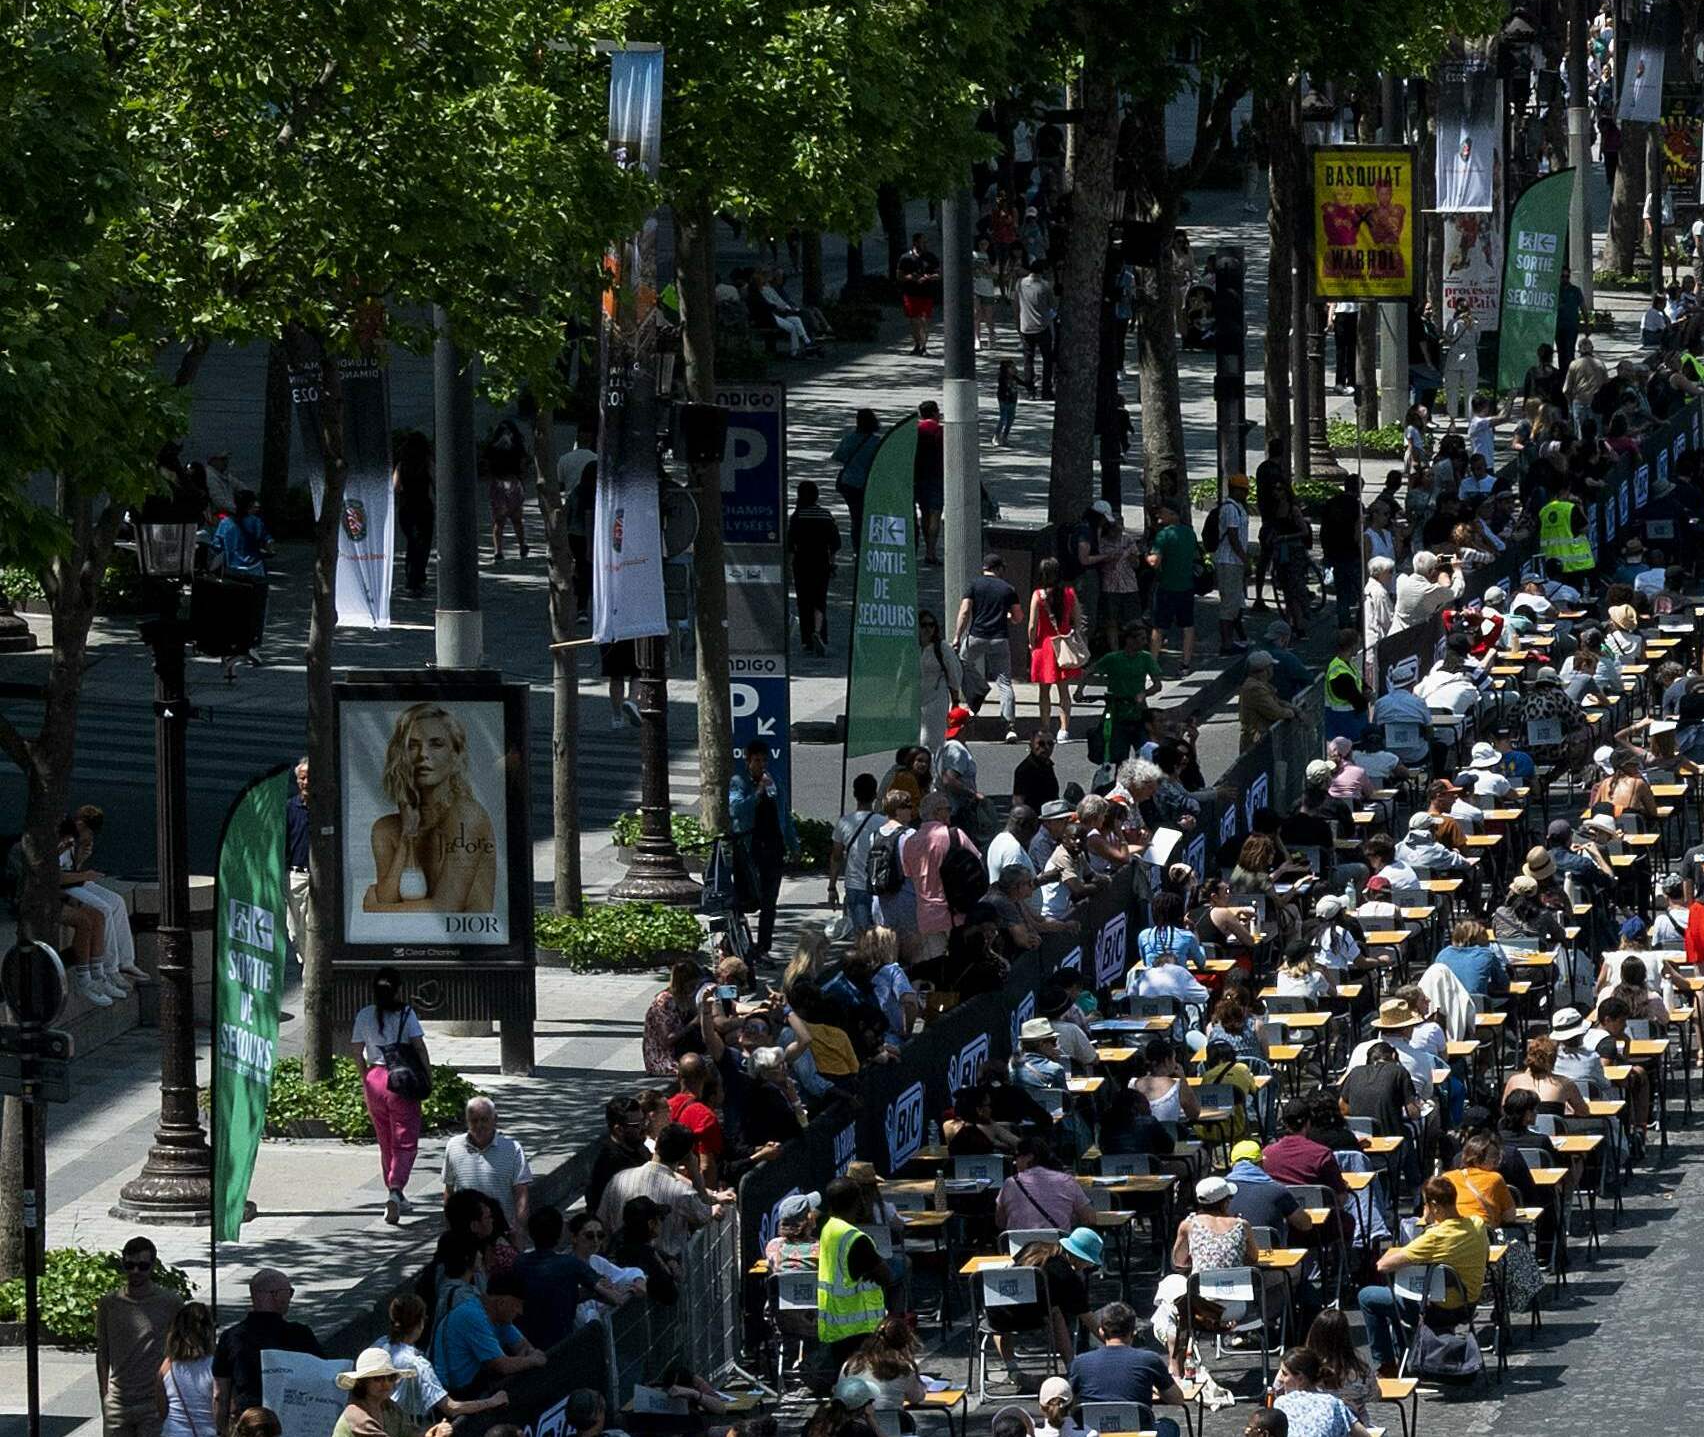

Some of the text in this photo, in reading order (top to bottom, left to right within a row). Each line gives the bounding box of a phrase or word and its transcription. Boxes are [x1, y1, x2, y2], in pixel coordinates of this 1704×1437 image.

[1326, 166, 1402, 187] BASQUIAT
[1330, 249, 1397, 271] WARHOL
[1515, 254, 1554, 273] SORTIE
[1524, 272, 1538, 289] DE
[1507, 288, 1555, 308] SECOURS
[720, 426, 769, 493] P
[866, 550, 907, 574] SORTIE
[873, 577, 891, 600] DE
[859, 603, 915, 627] SECOURS
[771, 749, 782, 760] V
[445, 917, 499, 934] DIOR
[406, 948, 427, 957] Clear
[227, 950, 274, 994] SORTIE
[240, 990, 256, 1026] DE
[219, 1022, 275, 1073] SECOURS
